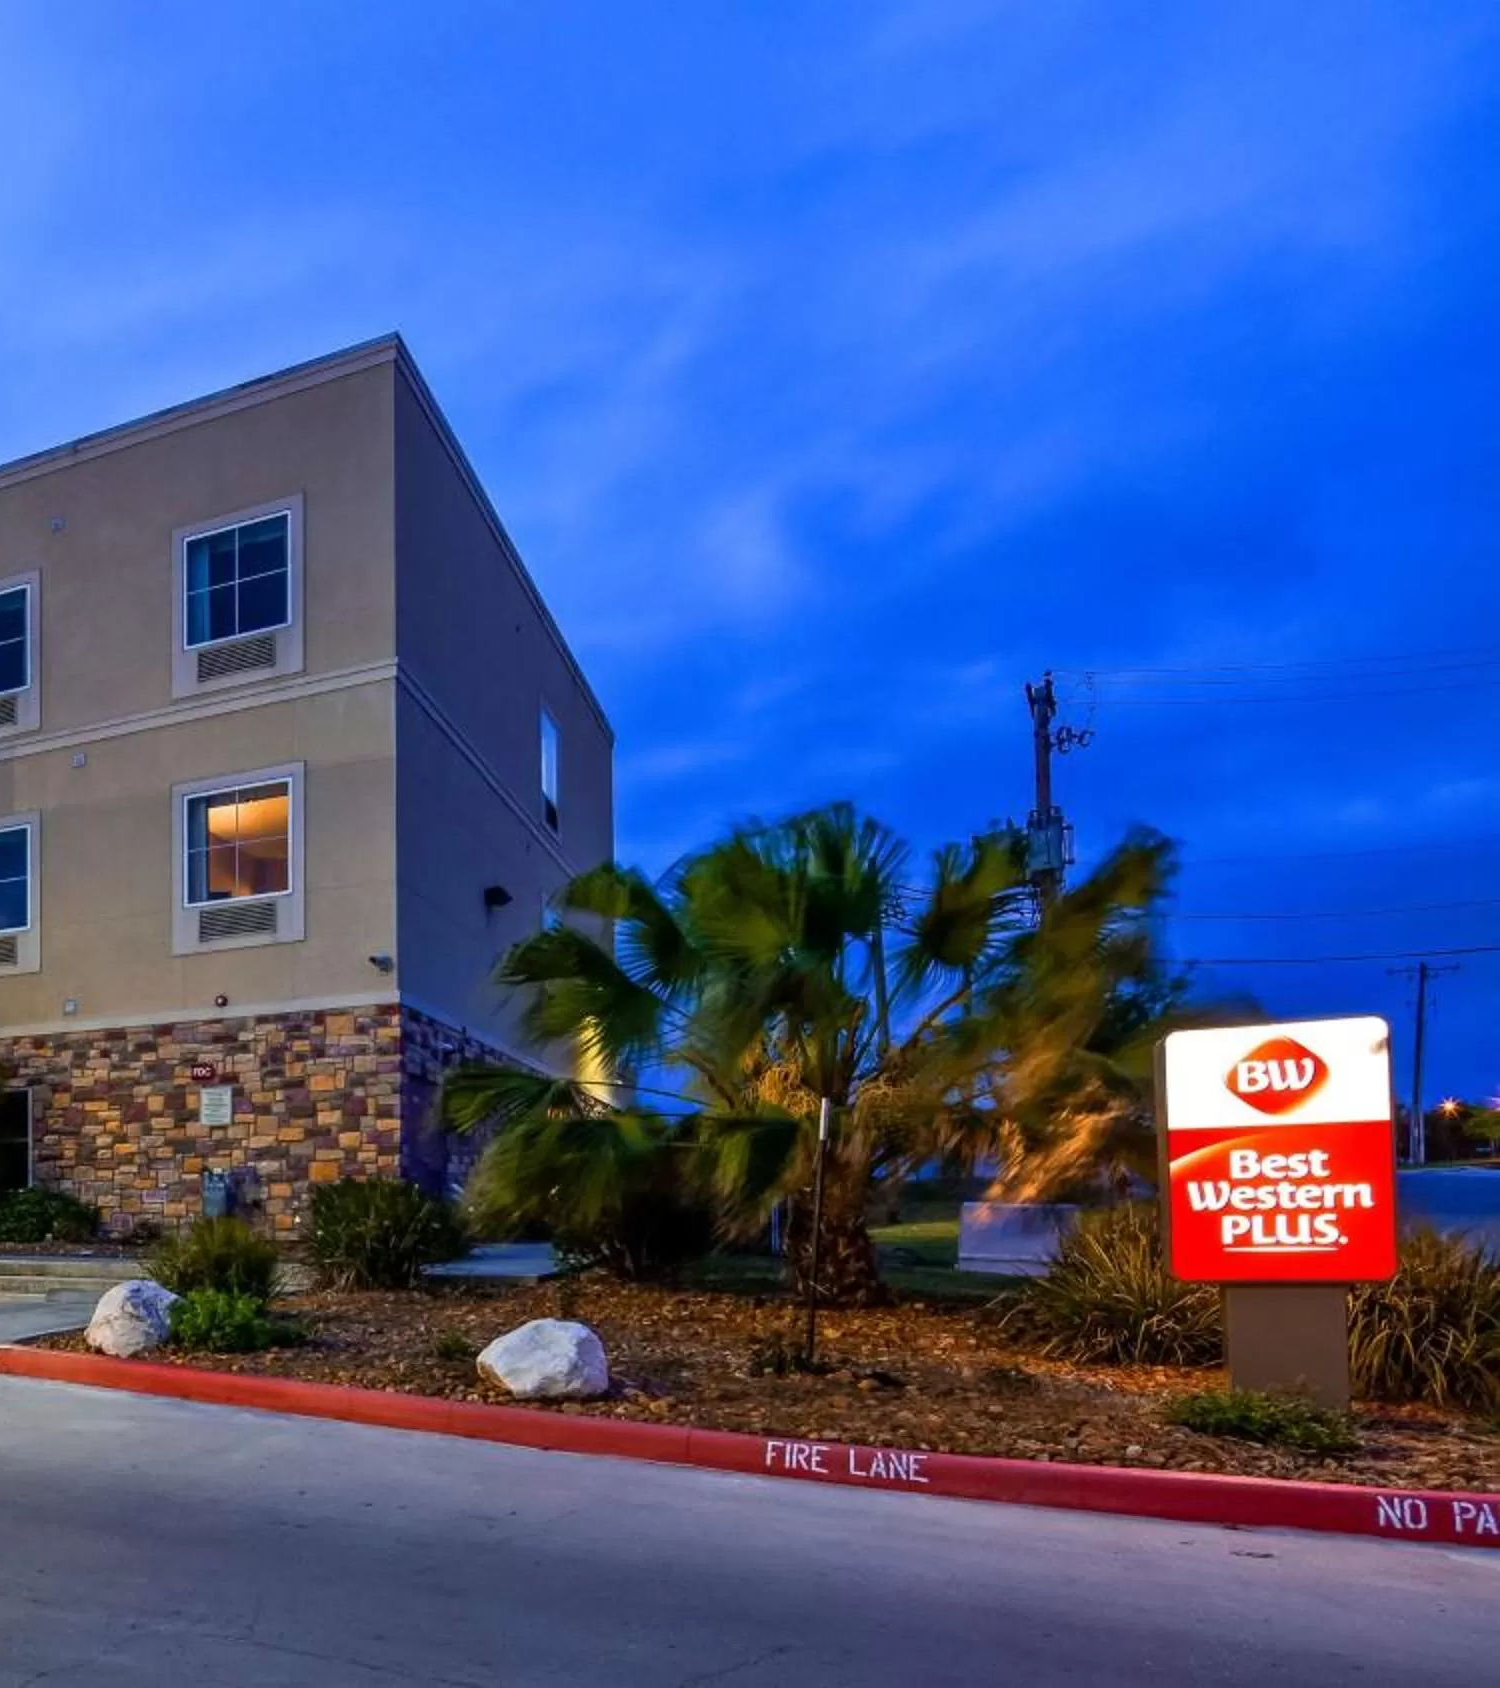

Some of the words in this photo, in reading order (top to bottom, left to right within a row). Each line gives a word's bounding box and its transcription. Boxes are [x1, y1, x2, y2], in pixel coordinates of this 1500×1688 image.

[1236, 1057, 1315, 1092] BW
[1229, 1149, 1330, 1179] Best
[1187, 1180, 1375, 1211] Western
[765, 1441, 831, 1474] FIRE
[849, 1448, 930, 1483] LANE
[1376, 1495, 1428, 1529] NO
[1452, 1500, 1500, 1535] PA
